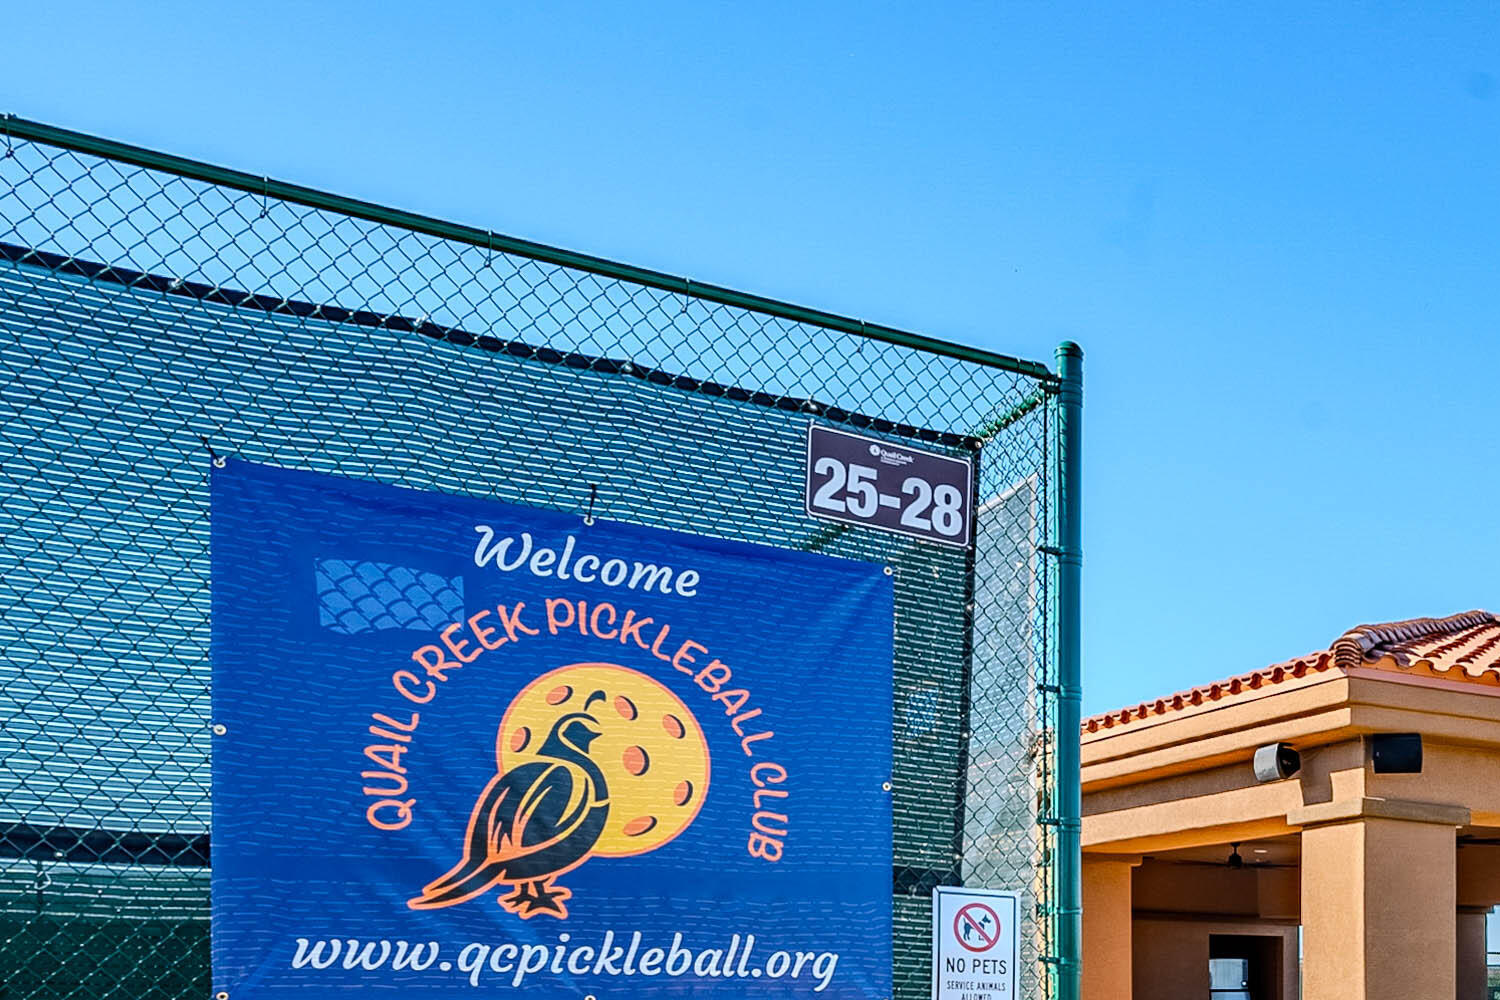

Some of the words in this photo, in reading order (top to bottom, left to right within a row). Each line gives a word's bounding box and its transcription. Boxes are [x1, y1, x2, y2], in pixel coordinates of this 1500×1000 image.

[812, 457, 964, 537] 25-28
[473, 525, 701, 598] Welcome
[361, 713, 420, 831] QUAIL
[392, 602, 540, 704] CREEK
[545, 598, 774, 756] PICKLEBALL
[748, 762, 789, 862] CLUB
[292, 930, 839, 992] www.qcpickleball.org
[946, 957, 966, 973] NO
[972, 958, 1007, 975] PETS
[946, 980, 974, 990] SERVICE
[976, 982, 1006, 992] ANIMALS
